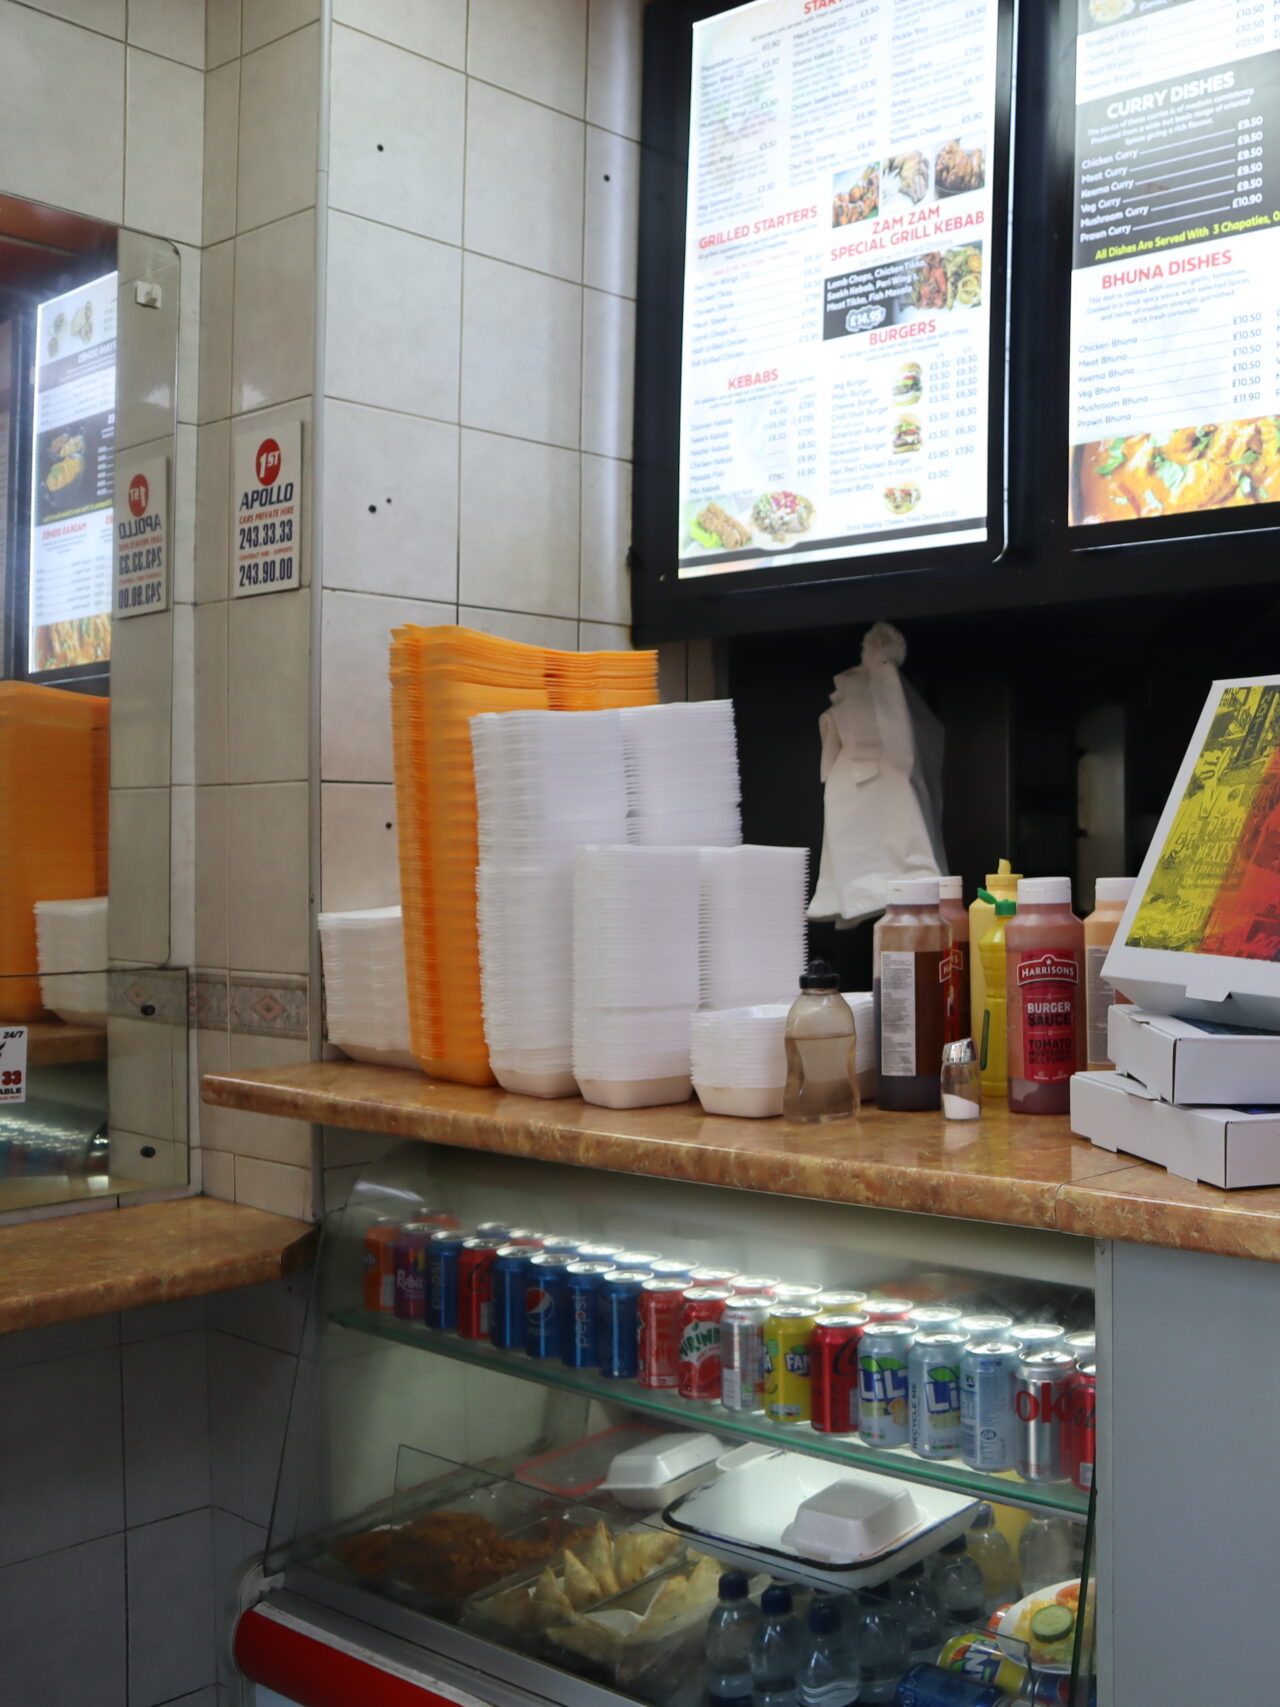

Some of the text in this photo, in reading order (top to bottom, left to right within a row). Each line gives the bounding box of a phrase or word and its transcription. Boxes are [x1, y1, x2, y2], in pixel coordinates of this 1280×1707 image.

[1107, 71, 1235, 120] CURRY DISHES
[1081, 115, 1263, 170] Chicken Curry £9.50
[1081, 162, 1263, 213] Veg Curry £9.50
[699, 205, 818, 250] GRILLED STARTERS
[872, 206, 940, 235] ZAM ZAM
[1080, 193, 1262, 243] Prawn Curry £10.90
[831, 211, 985, 262] SPECIAL GRILL KEBAB
[1095, 249, 1107, 260] All
[1109, 242, 1136, 258] Dishes
[1138, 241, 1153, 251] Are
[1155, 231, 1185, 247] Served
[1187, 227, 1209, 240] With
[1213, 224, 1219, 234] 3
[1102, 249, 1233, 290] BHUNA DISHES
[869, 319, 936, 346] BURGERS
[1079, 313, 1262, 354] Chicken Bhuna £10.50
[727, 368, 779, 390] KEBABS
[240, 482, 293, 511] APOLLO
[240, 506, 294, 525] CARS PRIVATE HIRE
[240, 520, 292, 550] 243.33.33
[239, 557, 292, 587] 243.90.00
[1022, 966, 1074, 978] HARRISONS
[1027, 1002, 1071, 1014] BURGER
[1028, 1013, 1072, 1026] SAUCE
[3, 1031, 24, 1039] 24/7
[1028, 1039, 1072, 1049] TOMATO
[575, 1295, 589, 1348] pepsi
